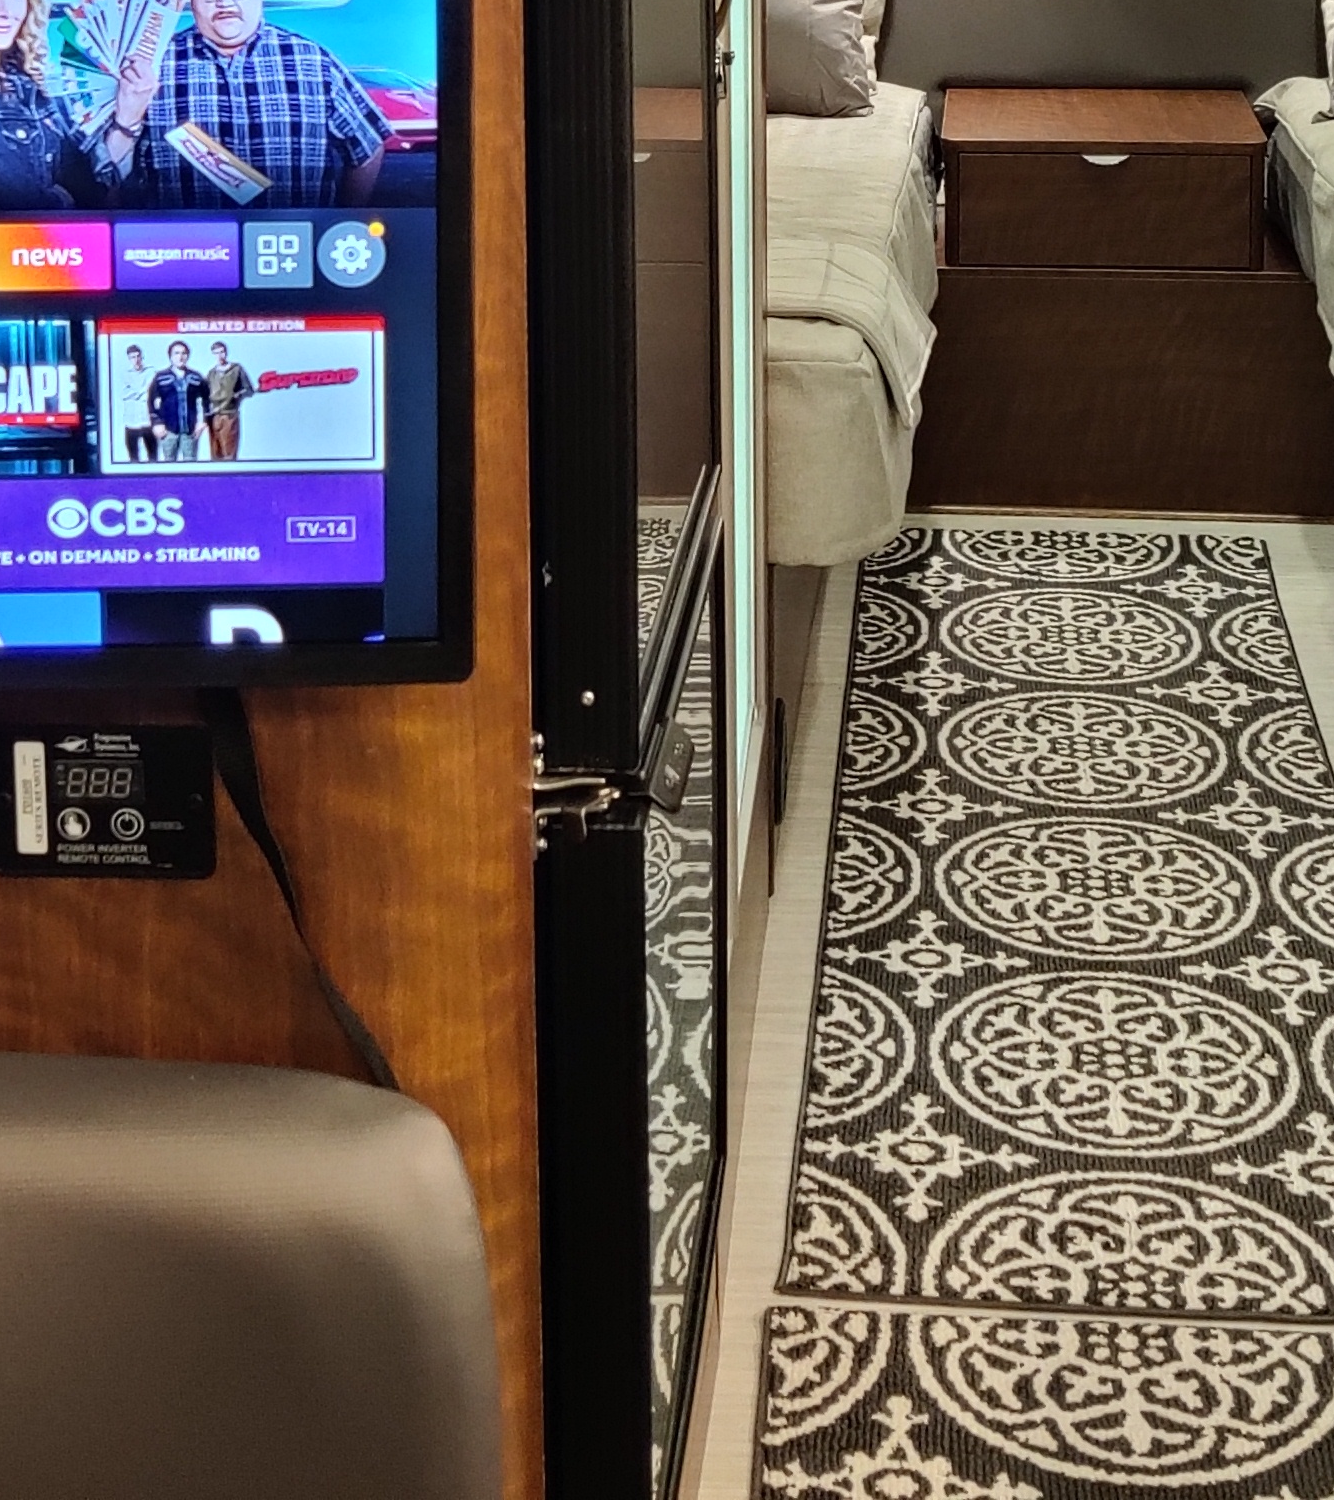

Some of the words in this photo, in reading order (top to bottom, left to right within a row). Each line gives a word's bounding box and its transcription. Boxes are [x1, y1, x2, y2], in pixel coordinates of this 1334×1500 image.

[11, 247, 84, 267] news
[124, 249, 181, 262] amazon
[182, 245, 230, 261] music
[177, 320, 245, 332] UNRATED
[246, 320, 305, 331] EDITION
[90, 498, 185, 536] CBS
[296, 522, 347, 537] TV-14
[29, 550, 58, 564] ON
[60, 549, 140, 564] DEMAND
[156, 546, 261, 563] STREAMING
[57, 843, 95, 853] POWER
[57, 854, 100, 864] REMOTE
